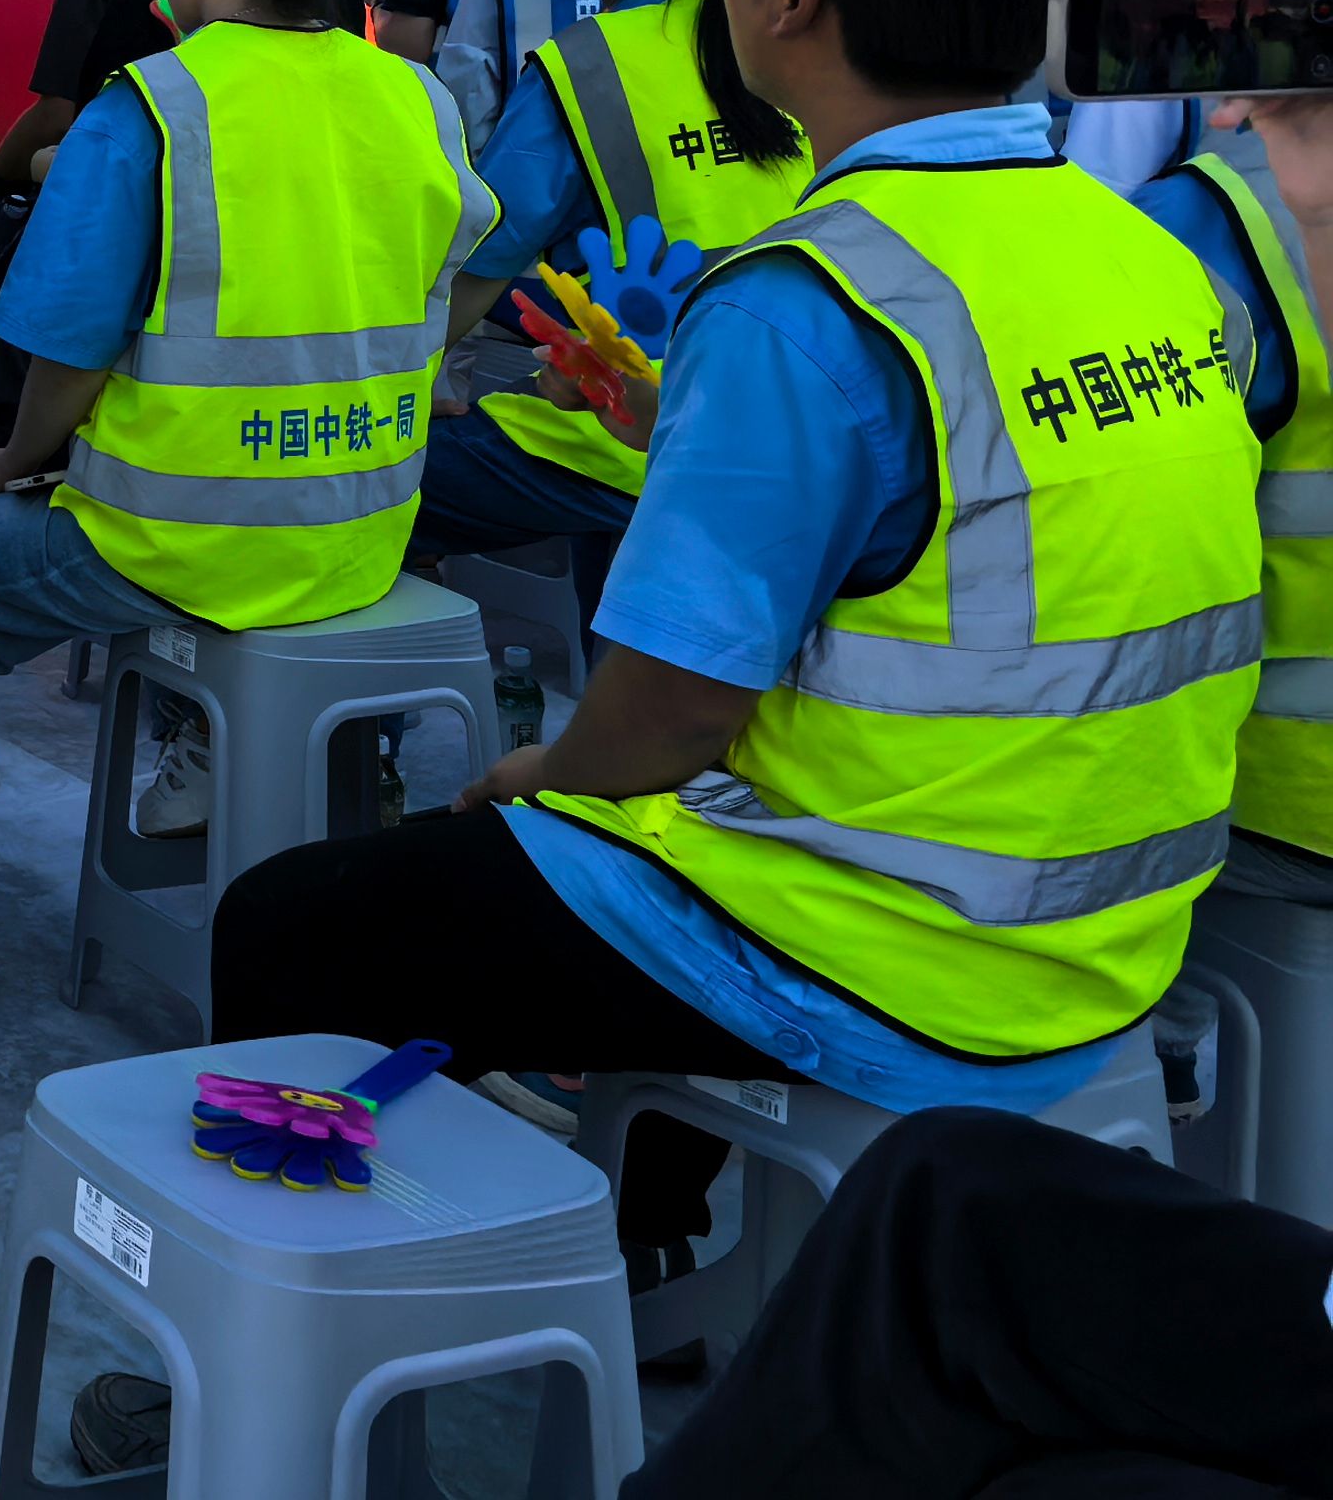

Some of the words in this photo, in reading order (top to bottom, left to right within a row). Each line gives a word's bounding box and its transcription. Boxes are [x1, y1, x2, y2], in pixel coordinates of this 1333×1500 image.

[240, 392, 416, 461] 中国中铁一局
